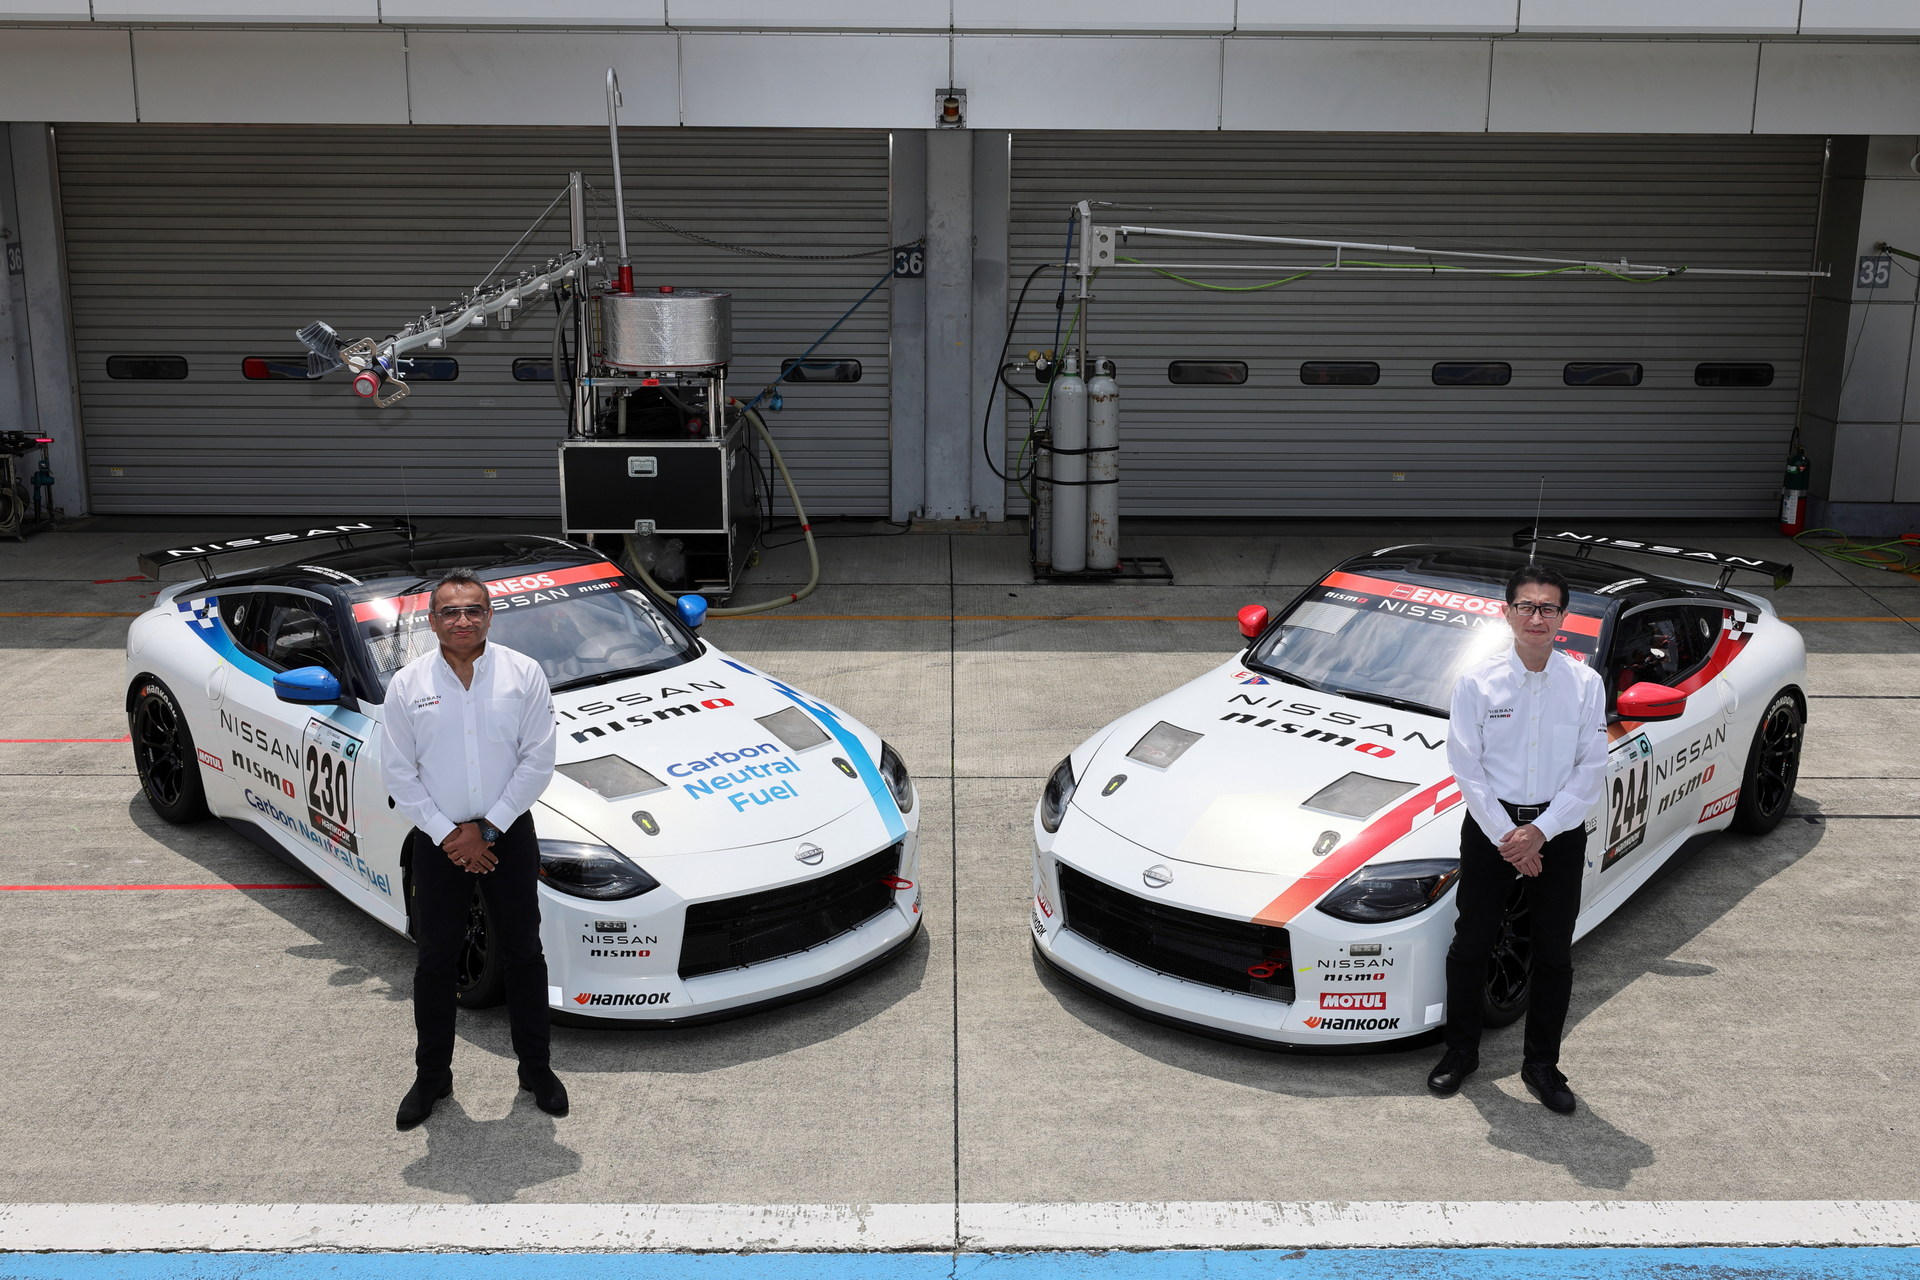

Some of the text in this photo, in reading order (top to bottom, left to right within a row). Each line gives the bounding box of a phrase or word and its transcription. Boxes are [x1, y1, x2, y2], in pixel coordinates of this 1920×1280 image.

[9, 247, 22, 271] 36
[896, 251, 922, 274] 36
[1860, 260, 1889, 284] 35
[167, 523, 372, 557] NISSAN
[1556, 531, 1764, 566] NISSAN
[486, 574, 555, 595] NEOS
[491, 588, 570, 610] SSAN
[1411, 588, 1502, 615] ENEOS
[386, 614, 429, 628] nism
[1378, 599, 1494, 627] NISSAN
[414, 695, 441, 704] NISSAN
[556, 680, 727, 725] ISSAN
[570, 698, 735, 743] nismo
[1228, 693, 1445, 750] NISSAN
[220, 709, 299, 769] NISSAN
[1219, 711, 1396, 759] nismo
[1640, 740, 1649, 753] Q
[199, 751, 223, 770] MOTUL
[345, 742, 357, 757] Q
[666, 742, 781, 778] Carbon
[1655, 724, 1726, 785] NISSAN
[232, 750, 295, 799] nismo
[306, 745, 348, 825] 230
[683, 756, 801, 800] Neutral
[727, 779, 799, 813] Fuel
[1609, 760, 1648, 845] 244
[1657, 764, 1715, 815] nismo
[1701, 793, 1738, 820] MOTUL
[244, 789, 392, 896] Carbon Neutral Fuel
[582, 935, 658, 944] NISSAN
[590, 949, 651, 958] nismo
[1317, 958, 1394, 968] NISSAN
[1324, 973, 1384, 981] nismo
[1322, 993, 1384, 1008] MOTUL
